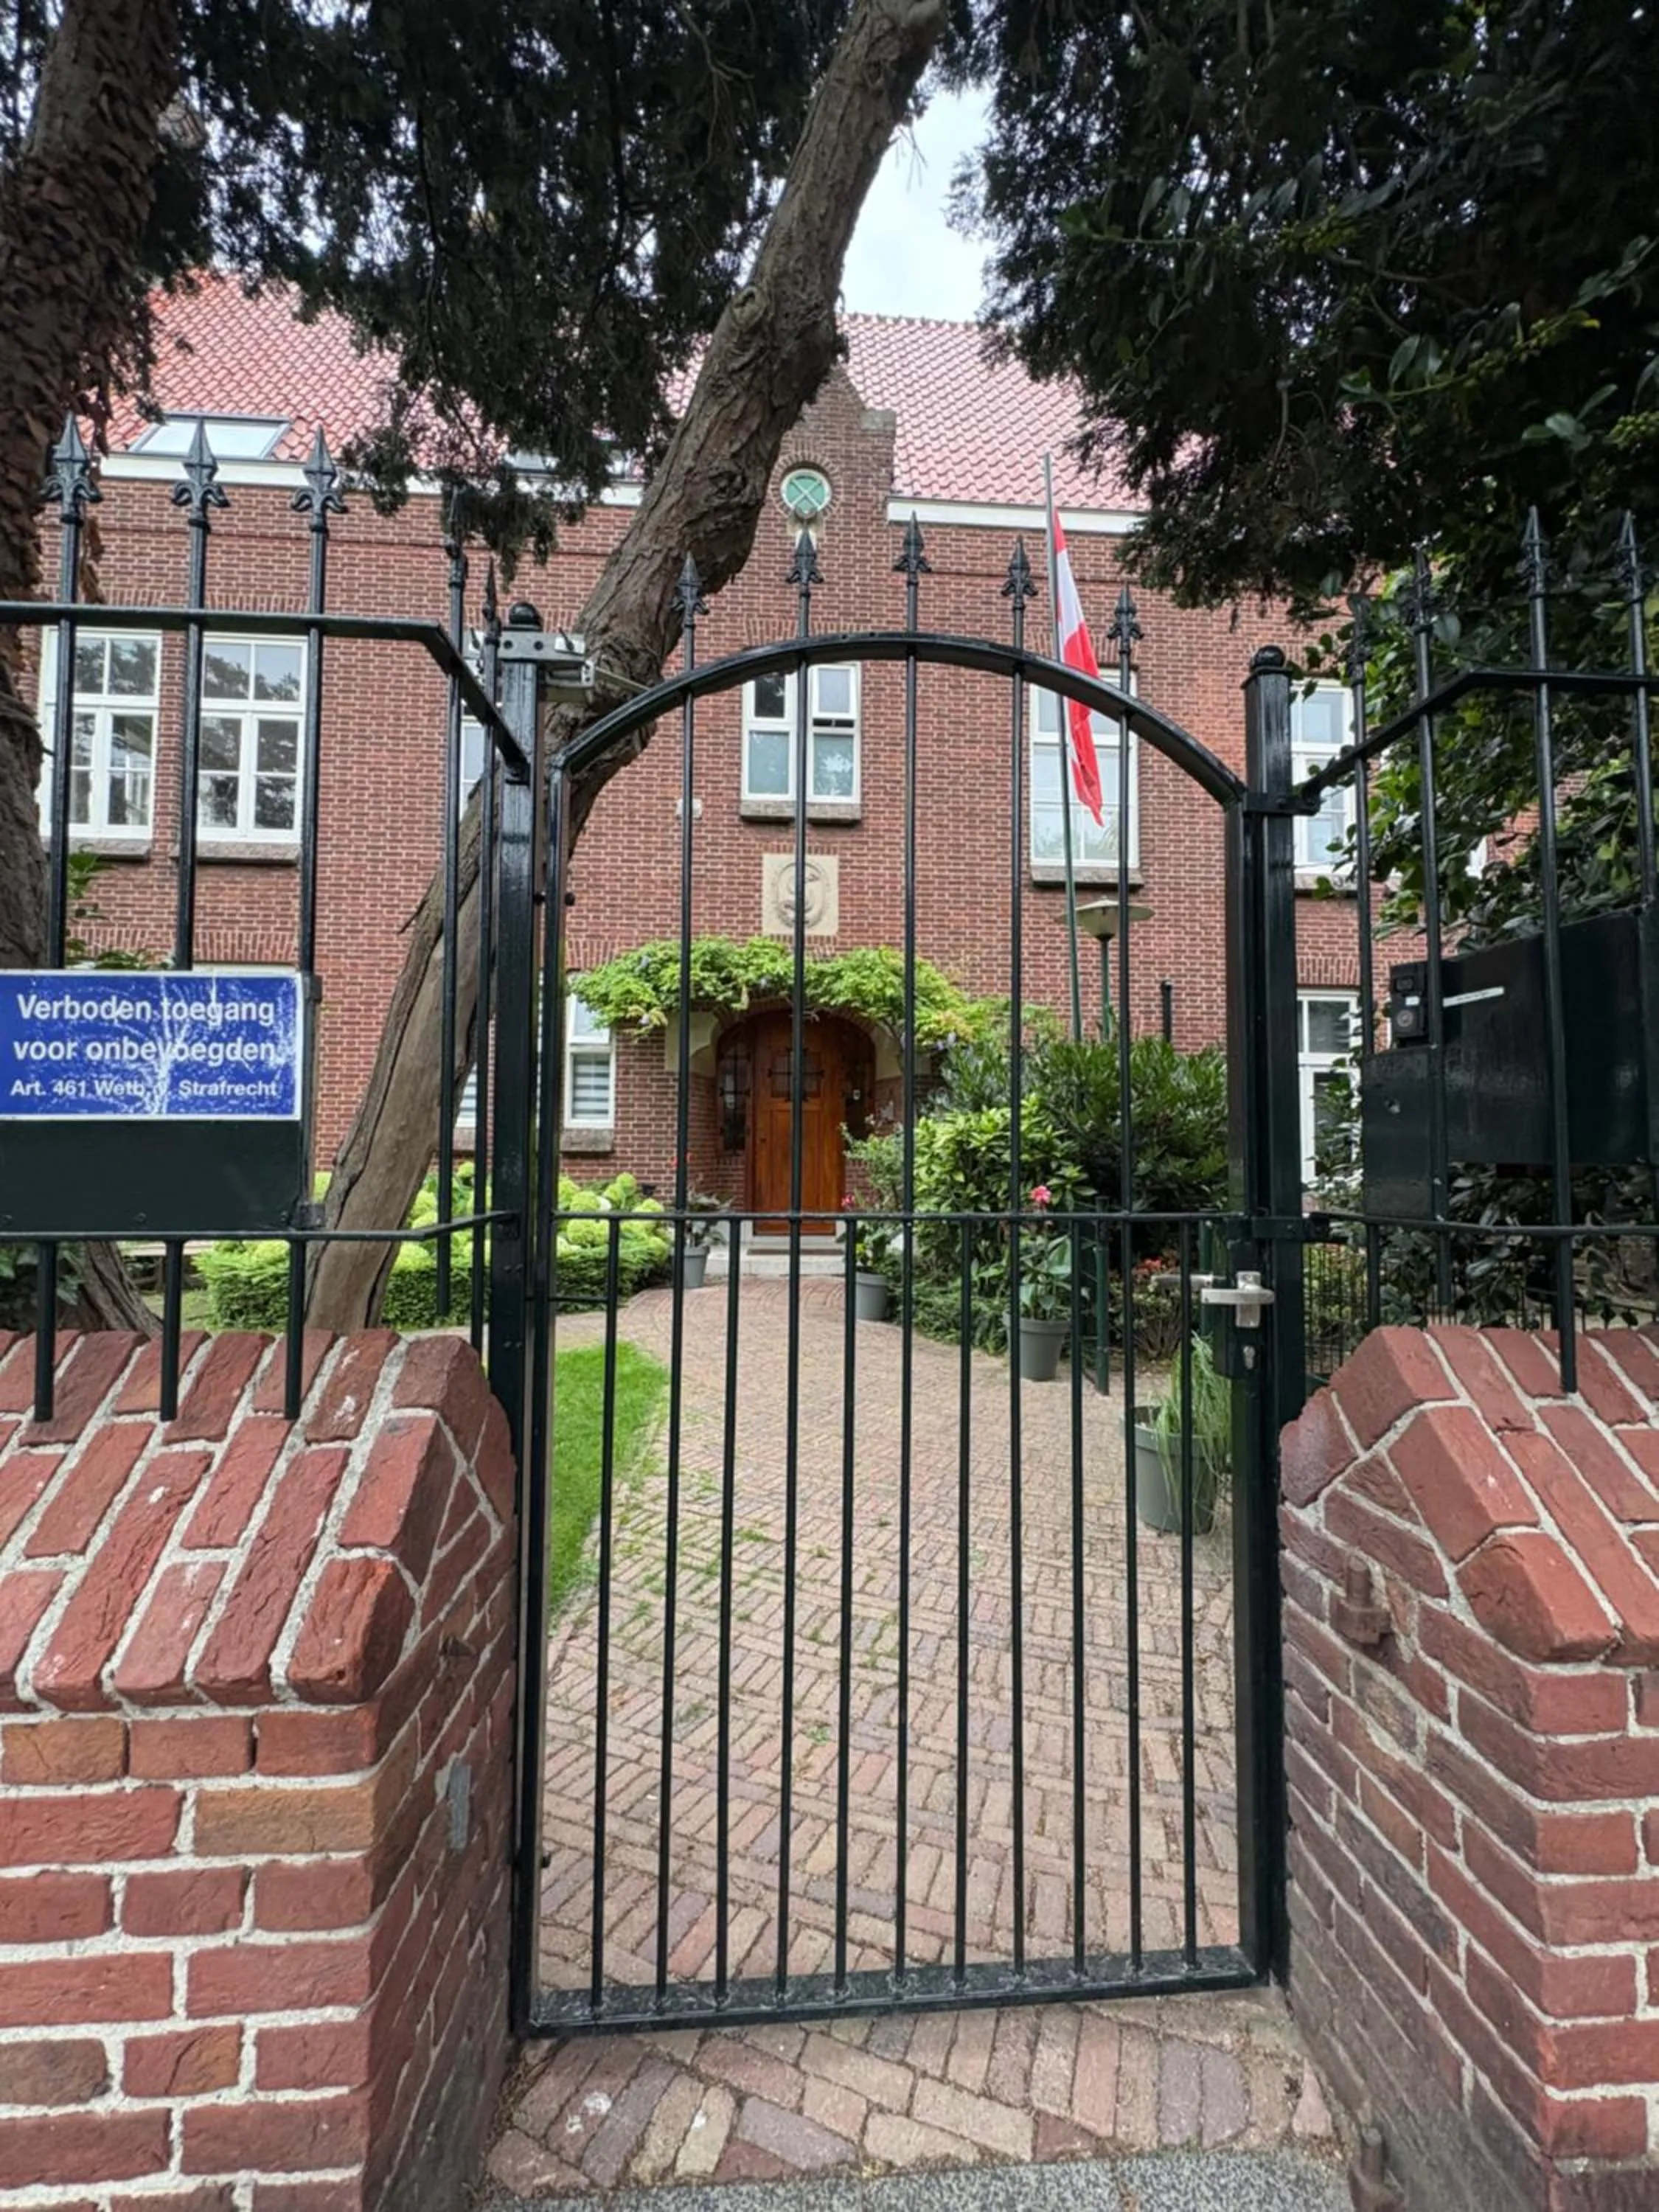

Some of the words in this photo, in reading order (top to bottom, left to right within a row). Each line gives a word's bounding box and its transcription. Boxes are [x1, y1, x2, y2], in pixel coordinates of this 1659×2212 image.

[17, 994, 151, 1020] Verboden
[163, 998, 275, 1027] toegang
[13, 1040, 76, 1061] voor
[86, 1037, 275, 1067] onbevoegden
[10, 1079, 46, 1096] Art.
[53, 1079, 86, 1096] 461
[178, 1079, 277, 1099] Strafrecht
